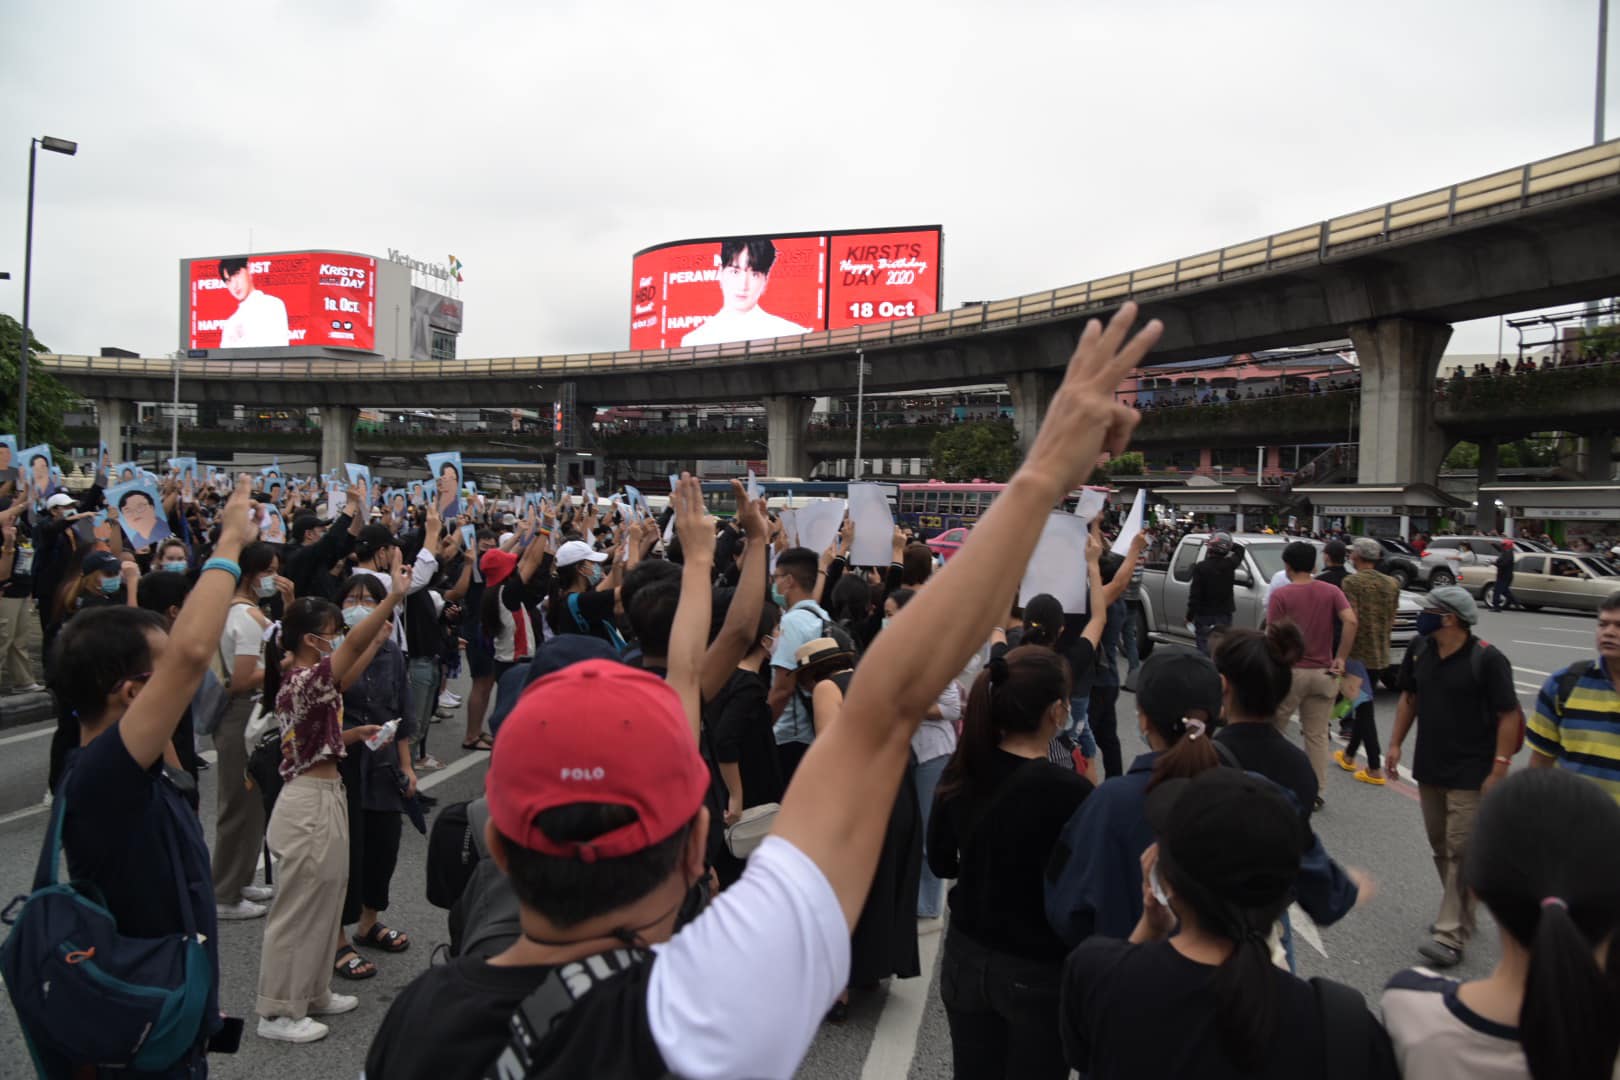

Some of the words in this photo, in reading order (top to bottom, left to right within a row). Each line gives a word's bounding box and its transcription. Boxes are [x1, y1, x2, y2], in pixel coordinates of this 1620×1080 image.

[847, 244, 921, 261] KIRST'S
[388, 248, 428, 275] Victory
[429, 263, 449, 281] Hub
[840, 259, 874, 275] Happy
[876, 257, 928, 274] Birthday
[340, 278, 366, 289] DAY
[842, 270, 882, 286] DAY
[849, 302, 873, 318] 18
[878, 301, 915, 317] Oct
[560, 766, 605, 781] POLO
